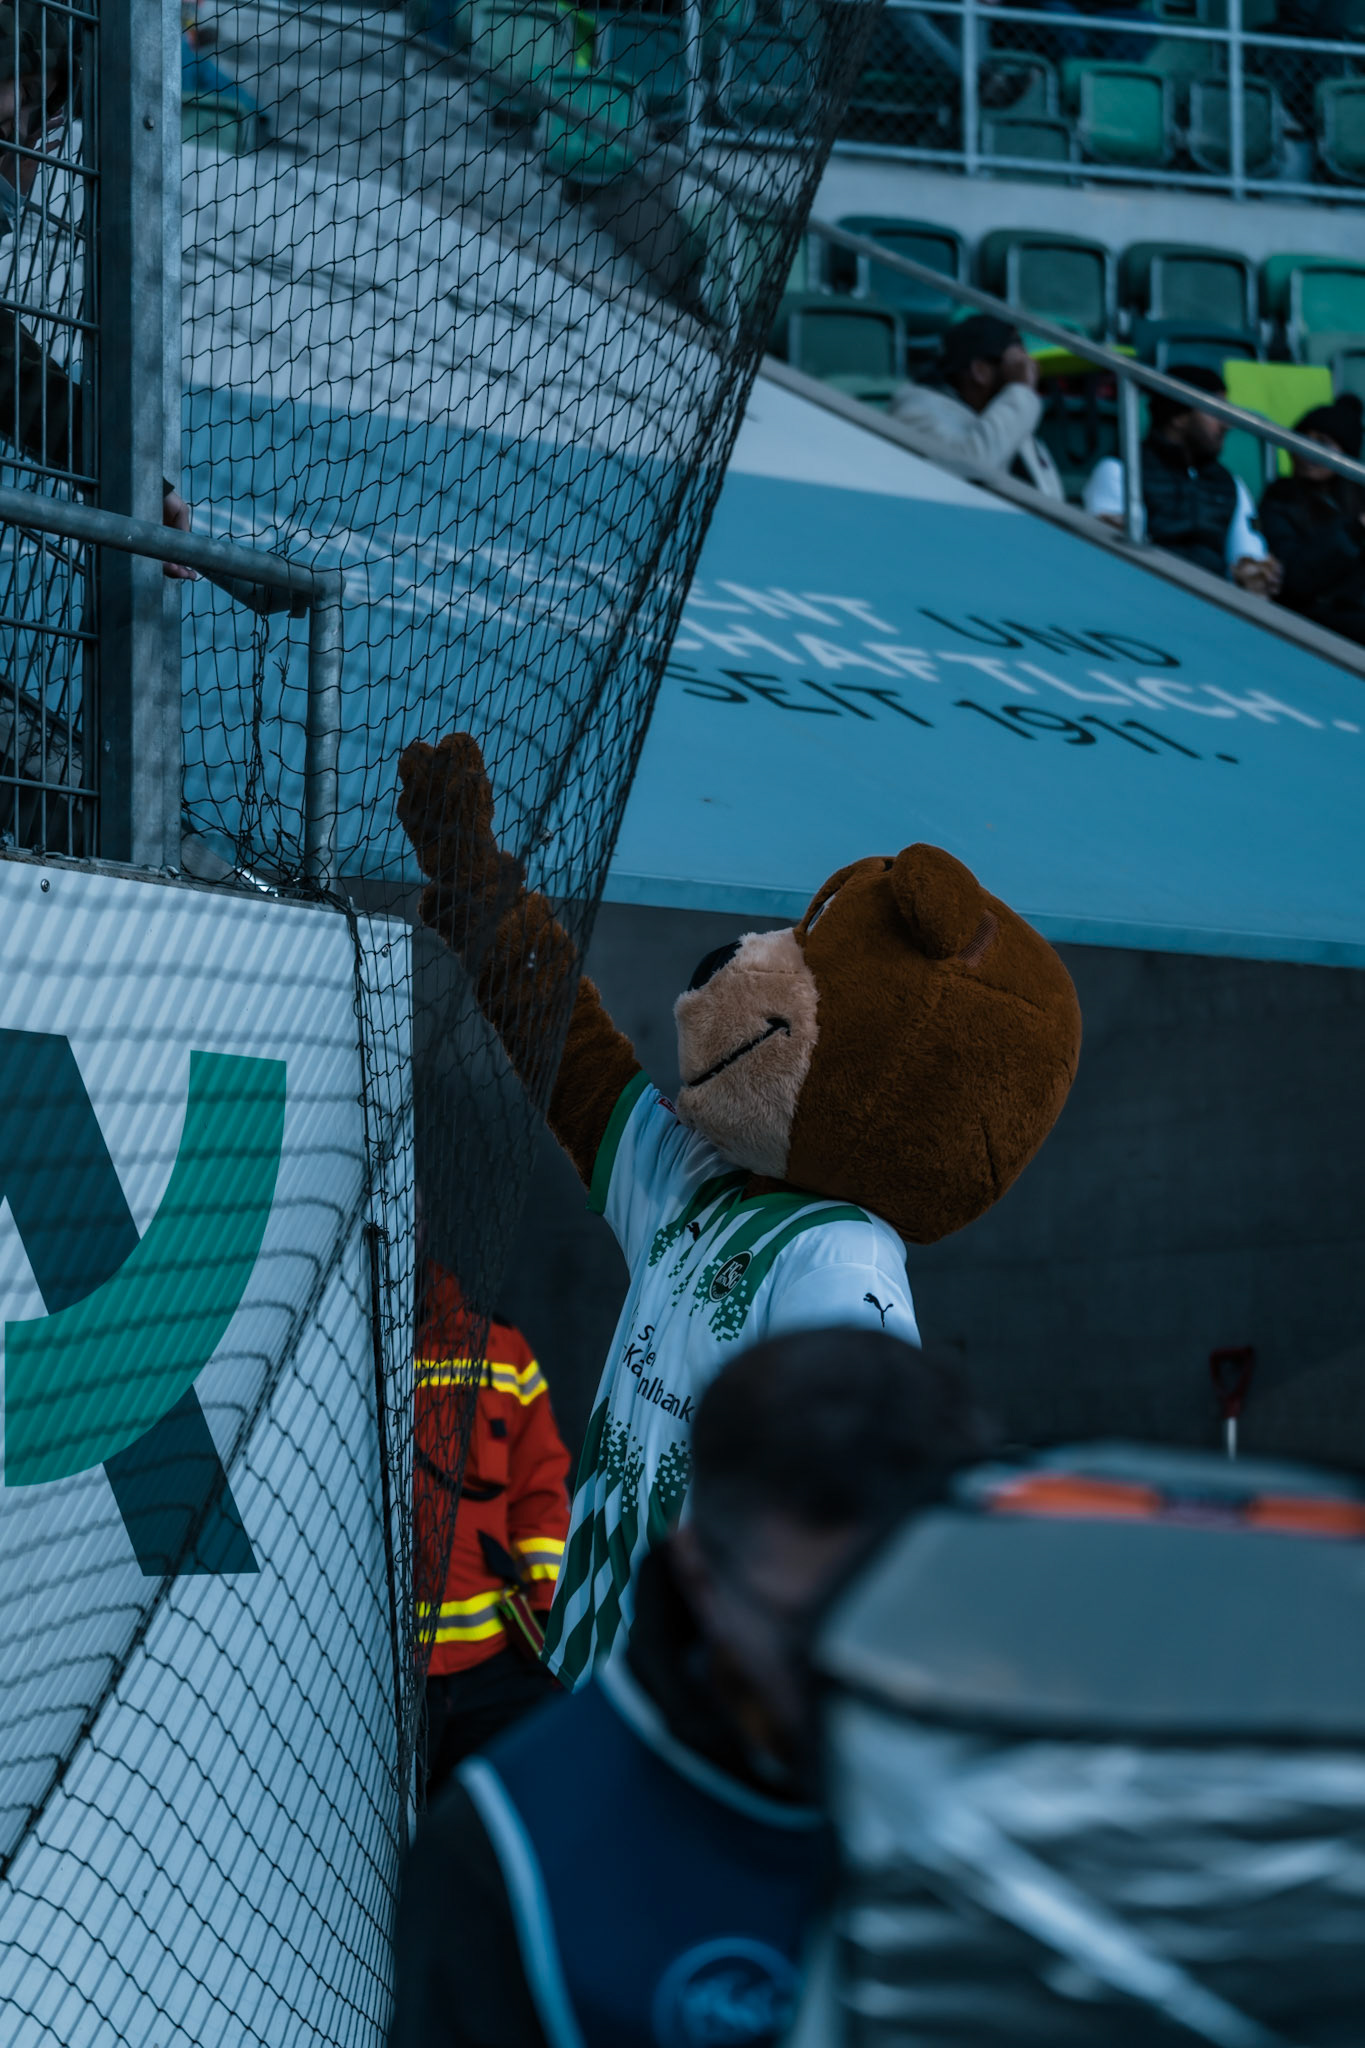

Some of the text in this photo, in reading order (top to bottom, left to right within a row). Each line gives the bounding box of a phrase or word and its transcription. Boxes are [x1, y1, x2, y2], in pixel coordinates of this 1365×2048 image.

[915, 608, 1183, 668] UND
[650, 656, 1241, 765] SEIT 1911.
